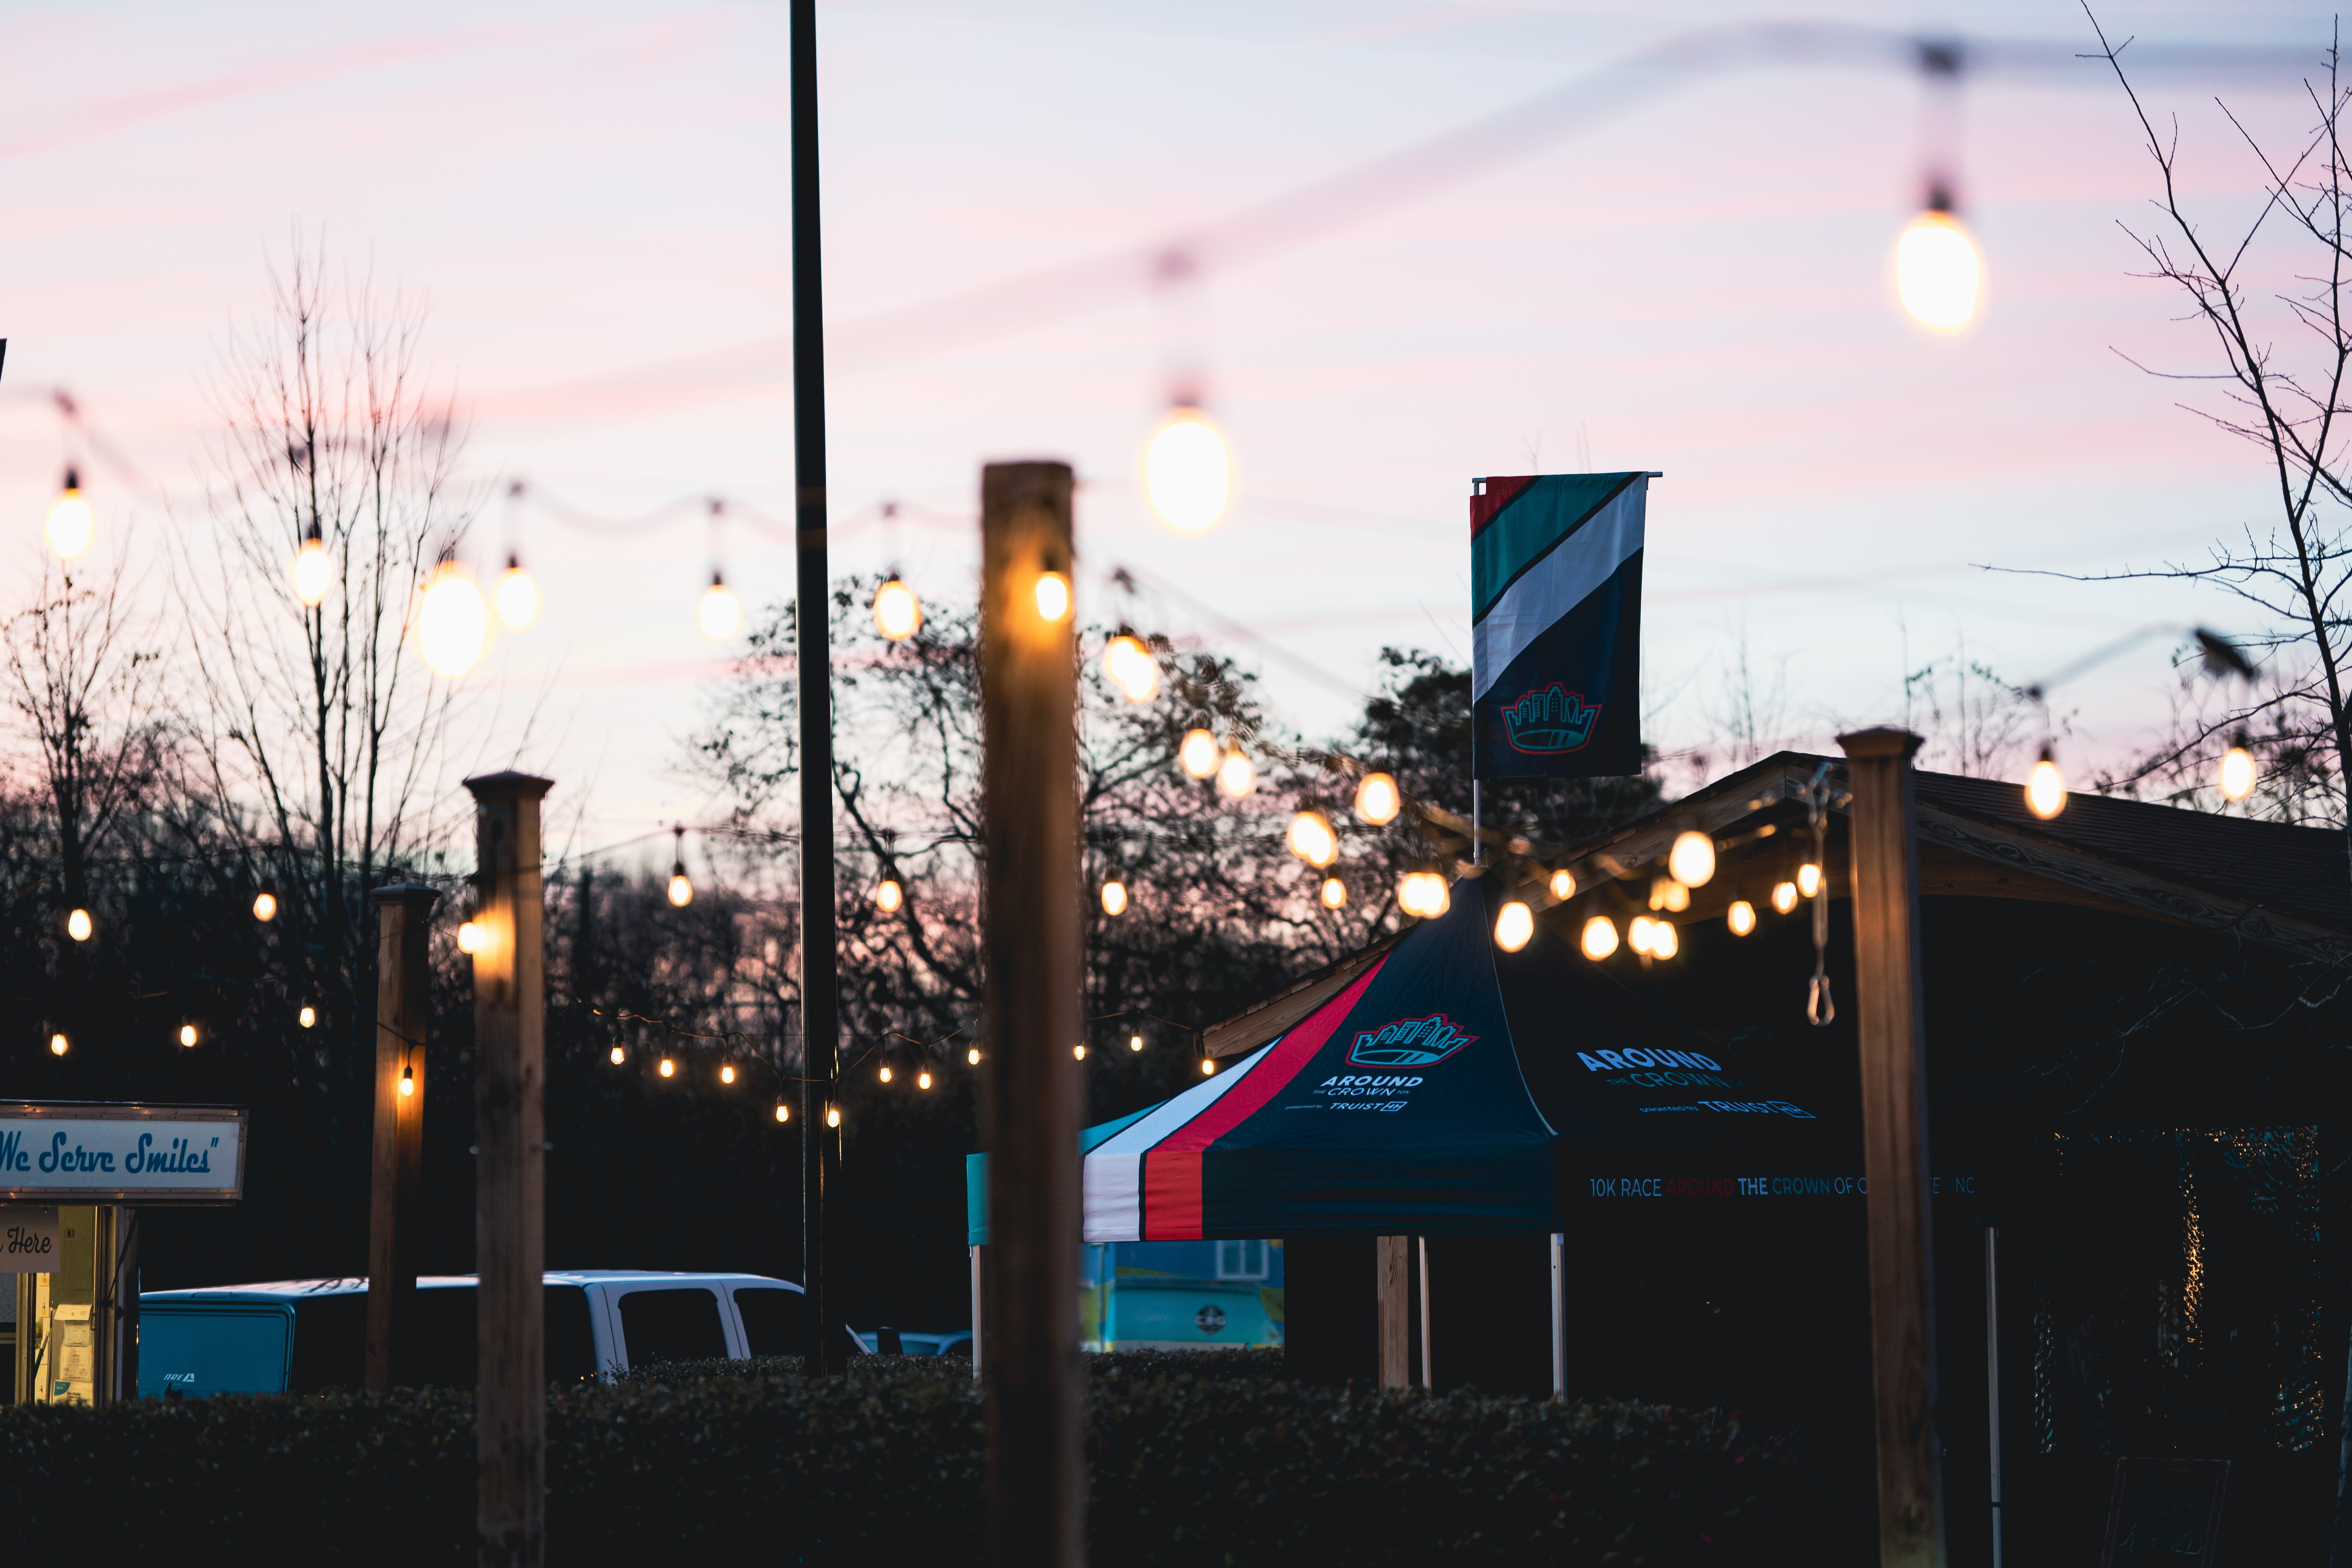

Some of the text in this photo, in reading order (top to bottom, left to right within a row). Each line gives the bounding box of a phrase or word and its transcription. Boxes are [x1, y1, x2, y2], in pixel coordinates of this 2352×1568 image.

[1577, 1048, 1721, 1071] AROUND
[1320, 1076, 1423, 1087] AROUND
[1606, 1077, 1632, 1085] THE
[1630, 1071, 1732, 1087] CROWN
[1328, 1087, 1396, 1096] CROWN
[1330, 1102, 1382, 1110] TRUIST
[1697, 1101, 1779, 1113] TRUIST
[0, 1131, 31, 1172] We
[38, 1131, 116, 1173] Serve
[1590, 1179, 1616, 1197] 10K
[1621, 1178, 1662, 1197] RACE
[1667, 1179, 1733, 1196] AROUND
[1738, 1178, 1768, 1195] THE
[1772, 1177, 1830, 1195] CROWN
[1834, 1177, 1853, 1194] OF
[1956, 1177, 1975, 1194] NC
[7, 1227, 52, 1254] Here
